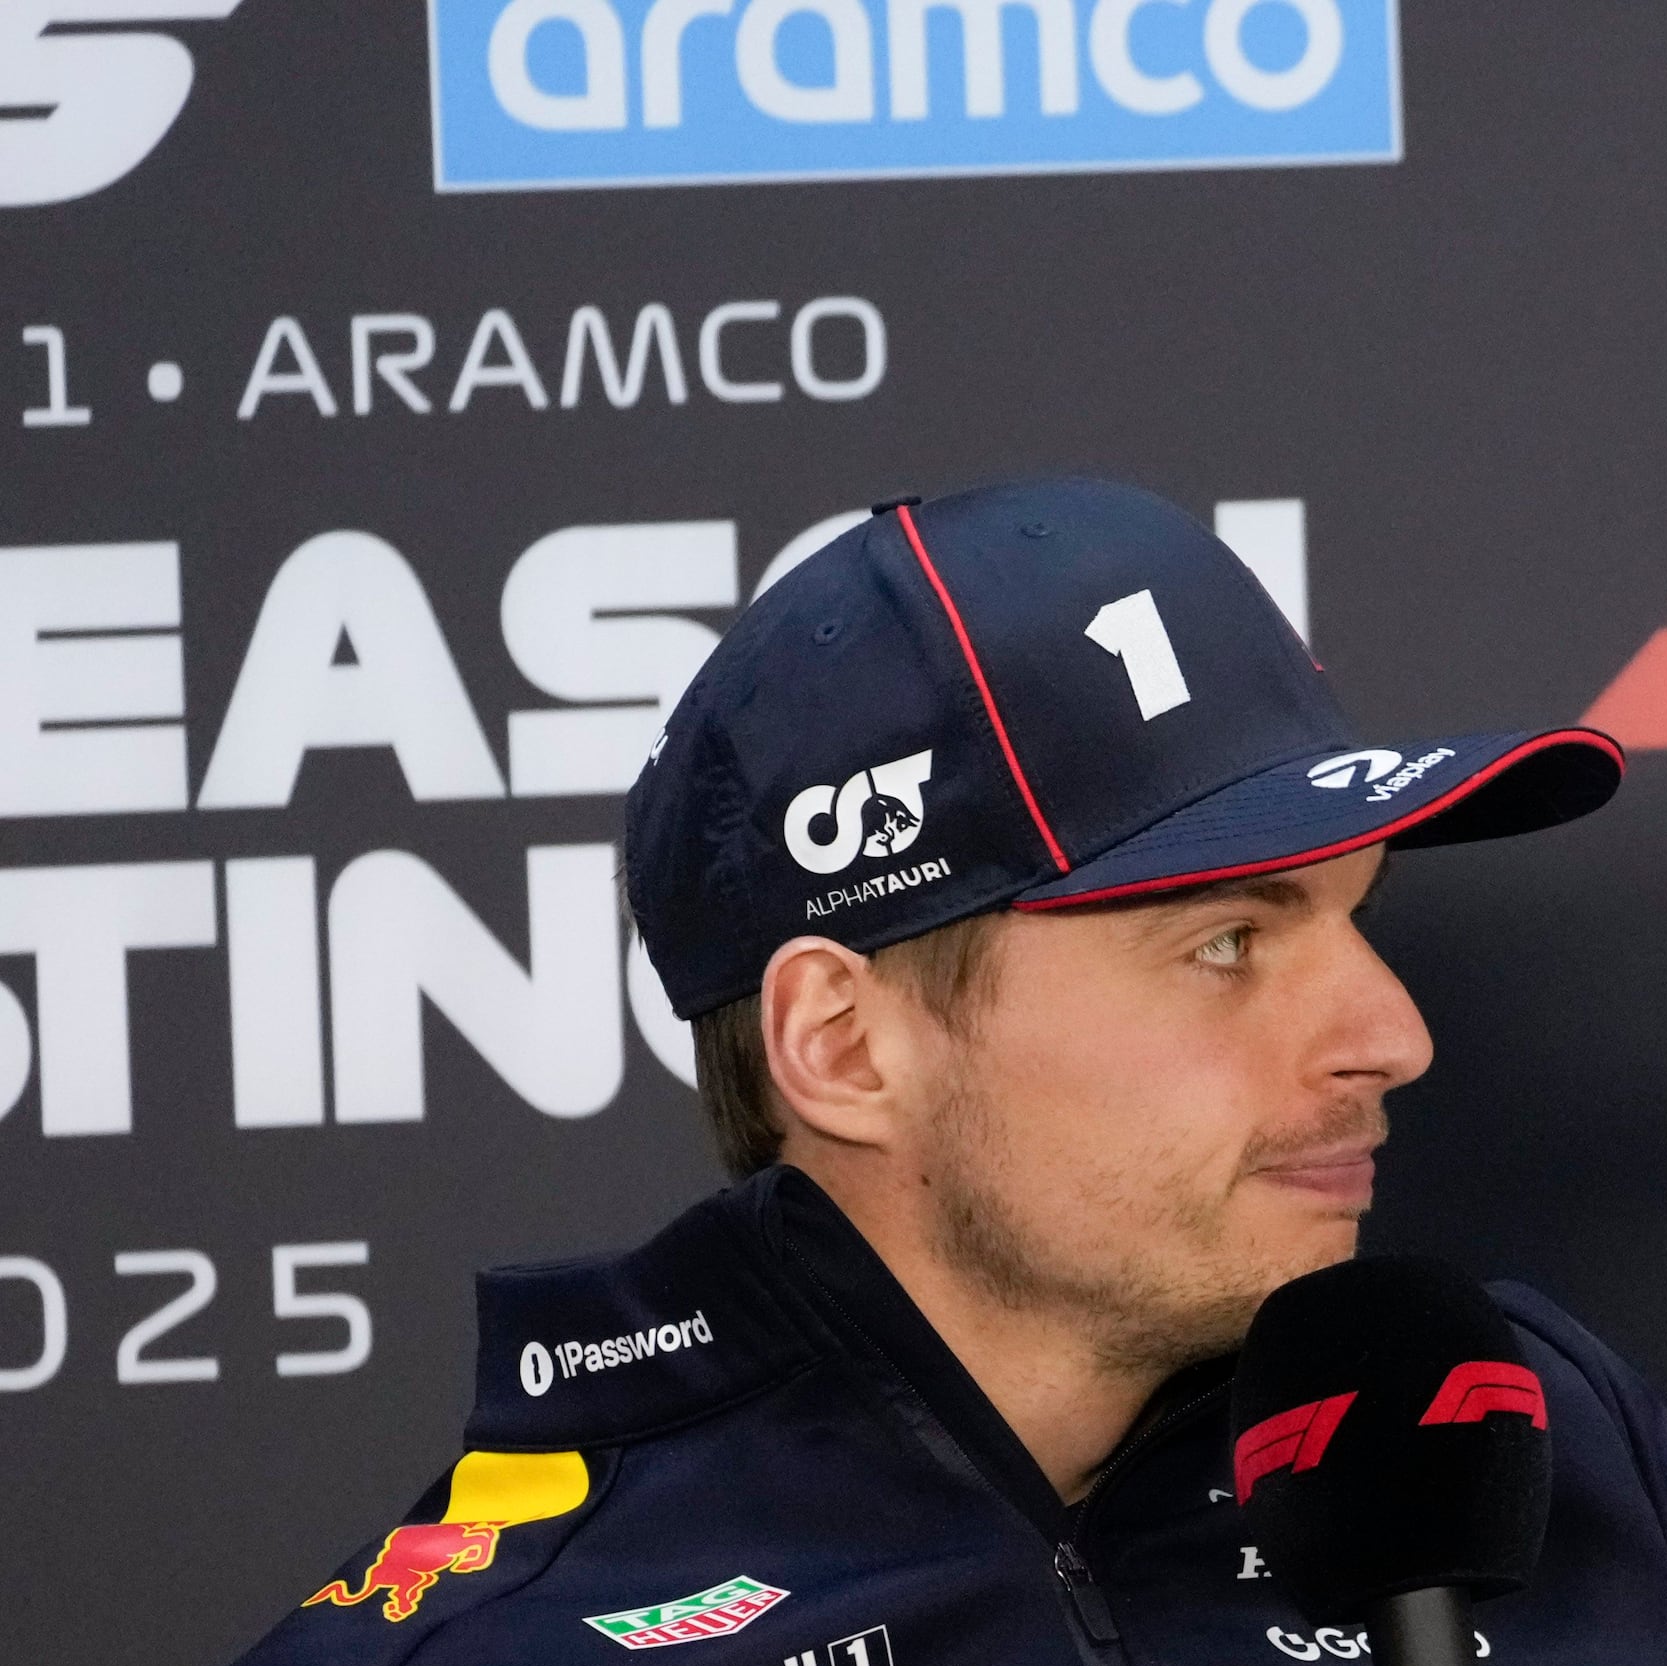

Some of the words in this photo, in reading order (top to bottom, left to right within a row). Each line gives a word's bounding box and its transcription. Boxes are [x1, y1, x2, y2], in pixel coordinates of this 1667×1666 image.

[487, 0, 1343, 131] aramco
[237, 296, 887, 421] ARAMCO
[0, 499, 1308, 818] EAS
[1084, 588, 1191, 721] 1
[1366, 748, 1456, 801] viaplay
[806, 858, 951, 920] ALPHATAURI
[0, 843, 700, 1137] TIN
[554, 1310, 713, 1379] 1Password
[604, 1585, 751, 1629] TAG
[628, 1590, 777, 1644] HEUER
